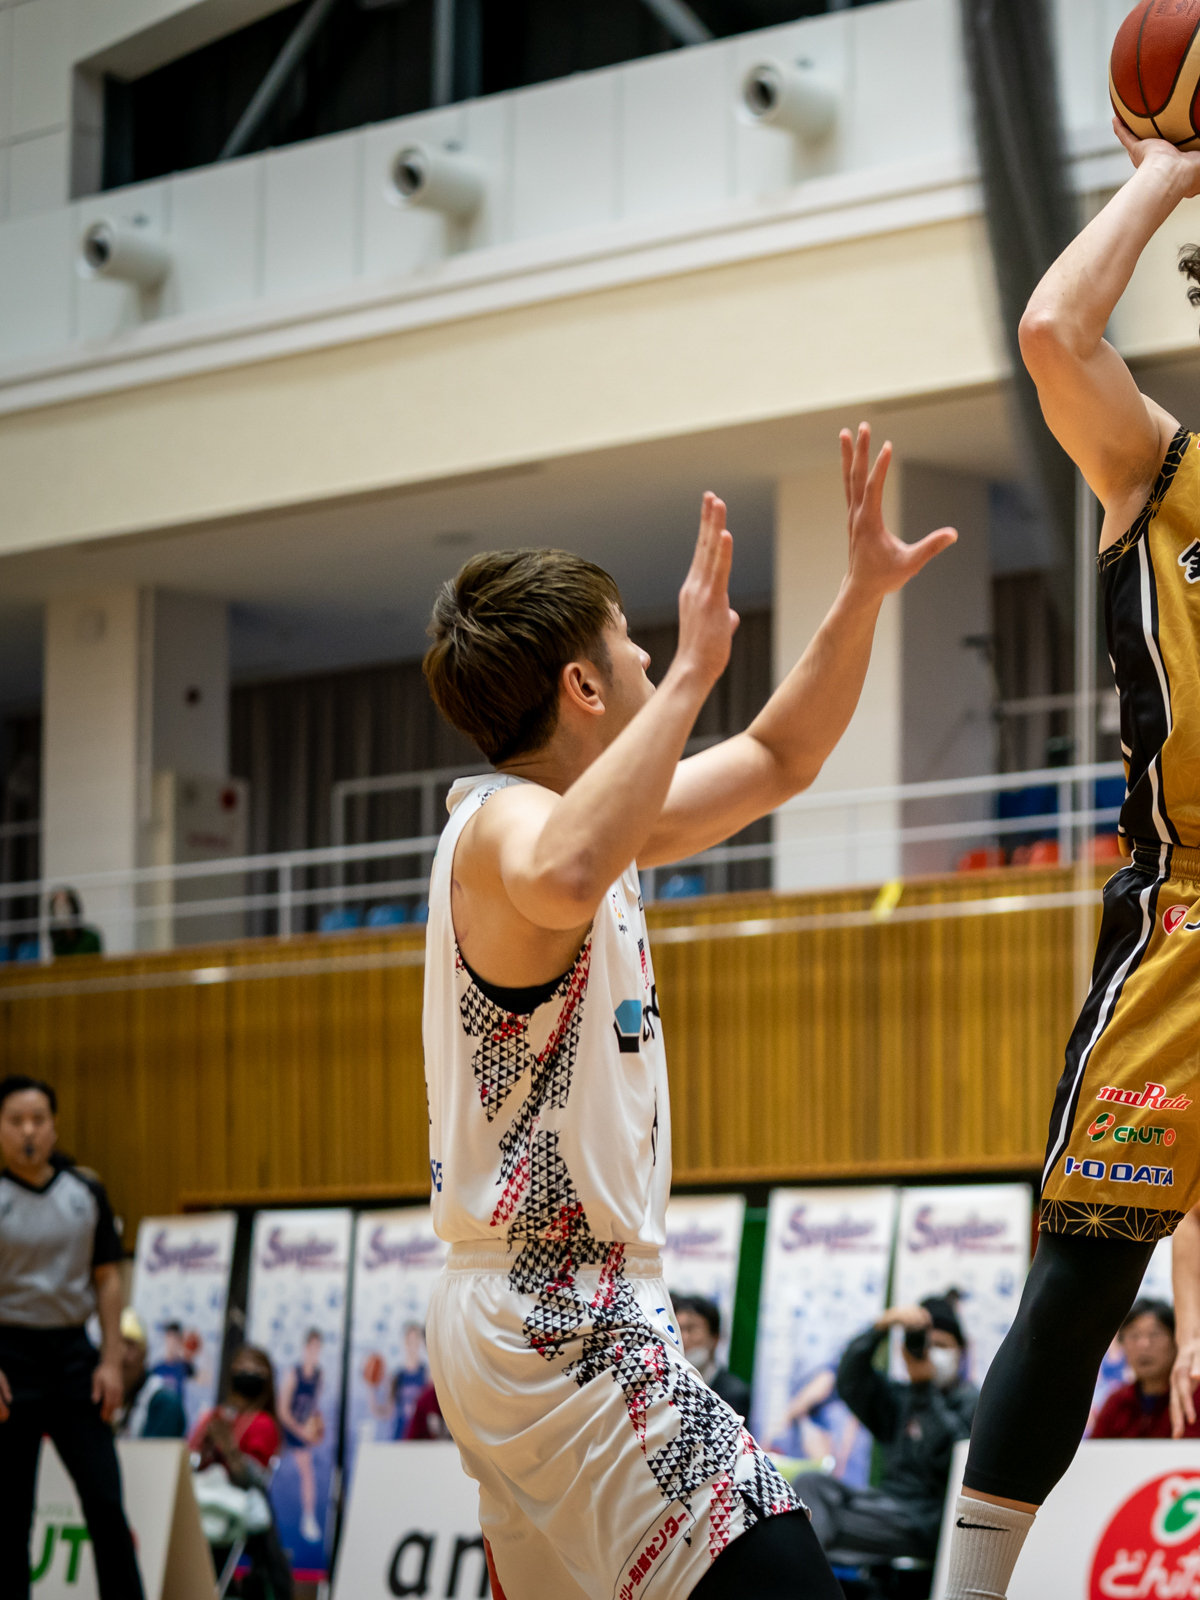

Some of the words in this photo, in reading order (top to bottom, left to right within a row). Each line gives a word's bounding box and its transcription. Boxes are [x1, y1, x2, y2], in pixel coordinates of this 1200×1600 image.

[1109, 1163, 1175, 1187] DATA
[619, 1512, 687, 1600] リー引越センター
